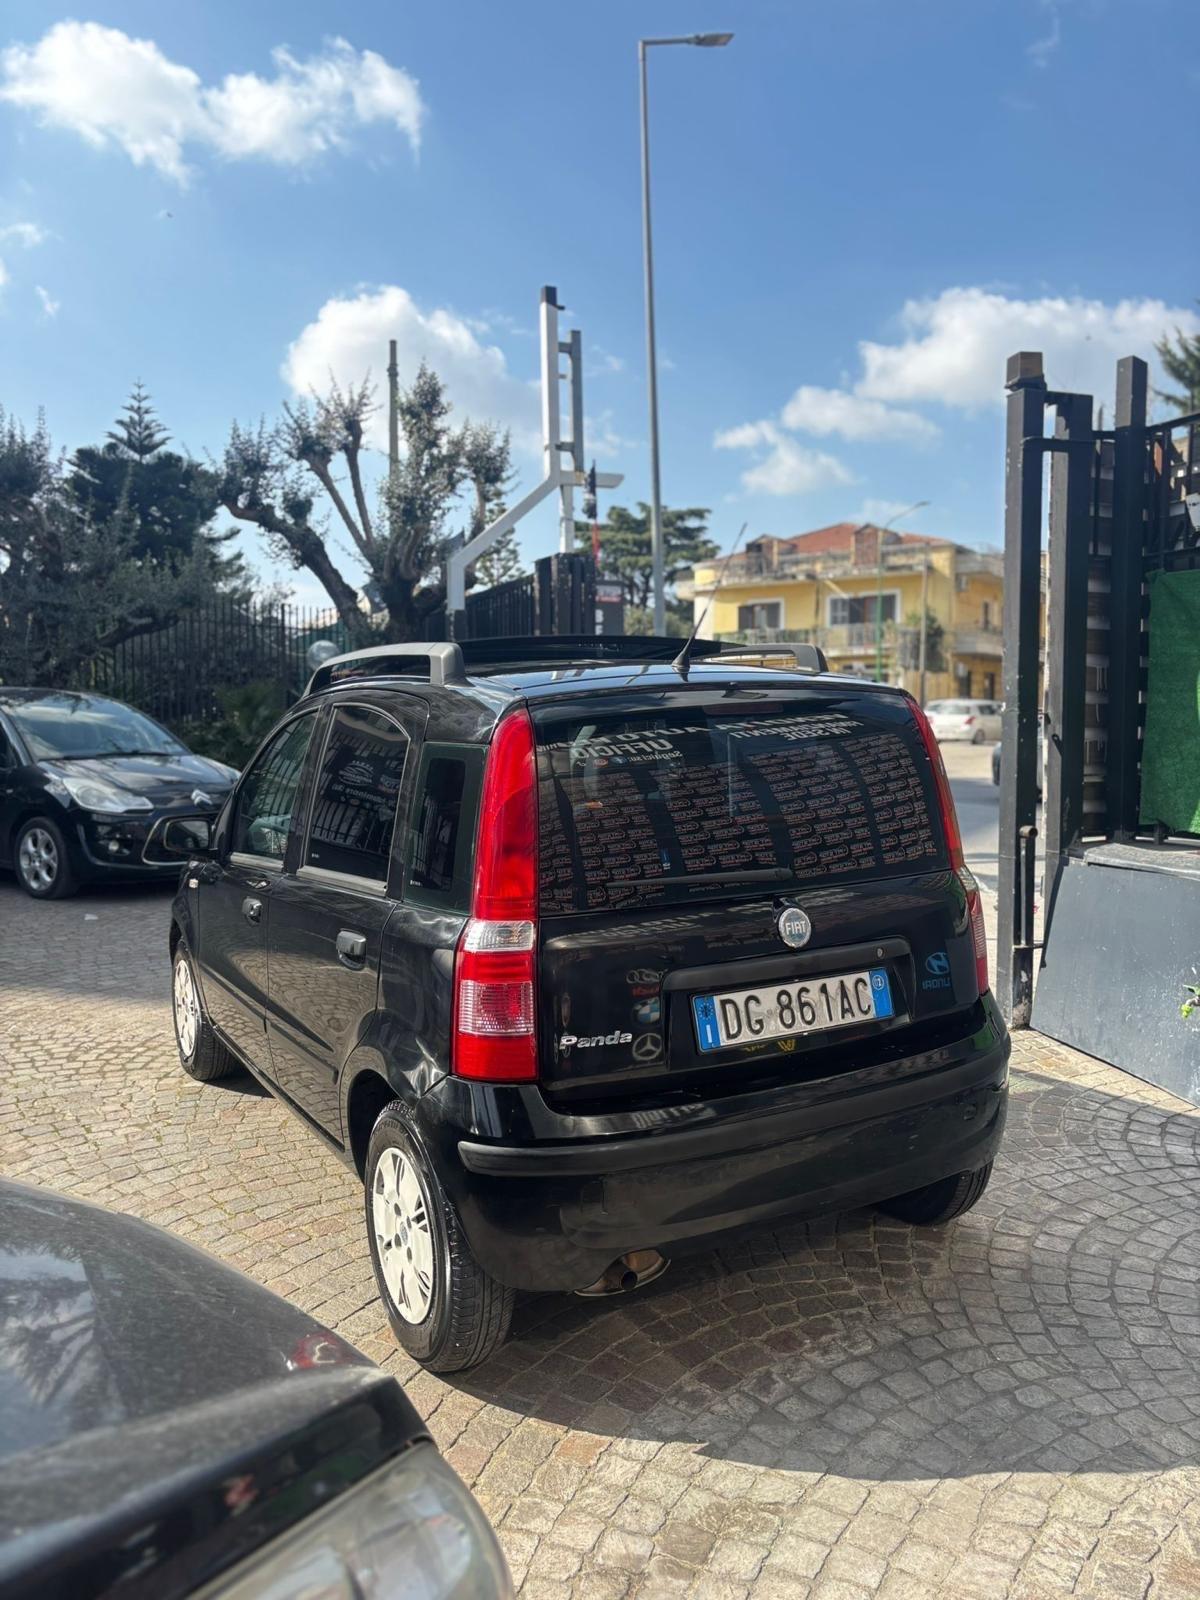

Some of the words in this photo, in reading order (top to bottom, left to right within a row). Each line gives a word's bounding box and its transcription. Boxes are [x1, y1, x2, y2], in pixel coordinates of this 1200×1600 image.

[785, 920, 806, 936] FIAT
[719, 995, 765, 1041] DG
[776, 977, 872, 1029] 861AC
[559, 1030, 633, 1050] Panda
